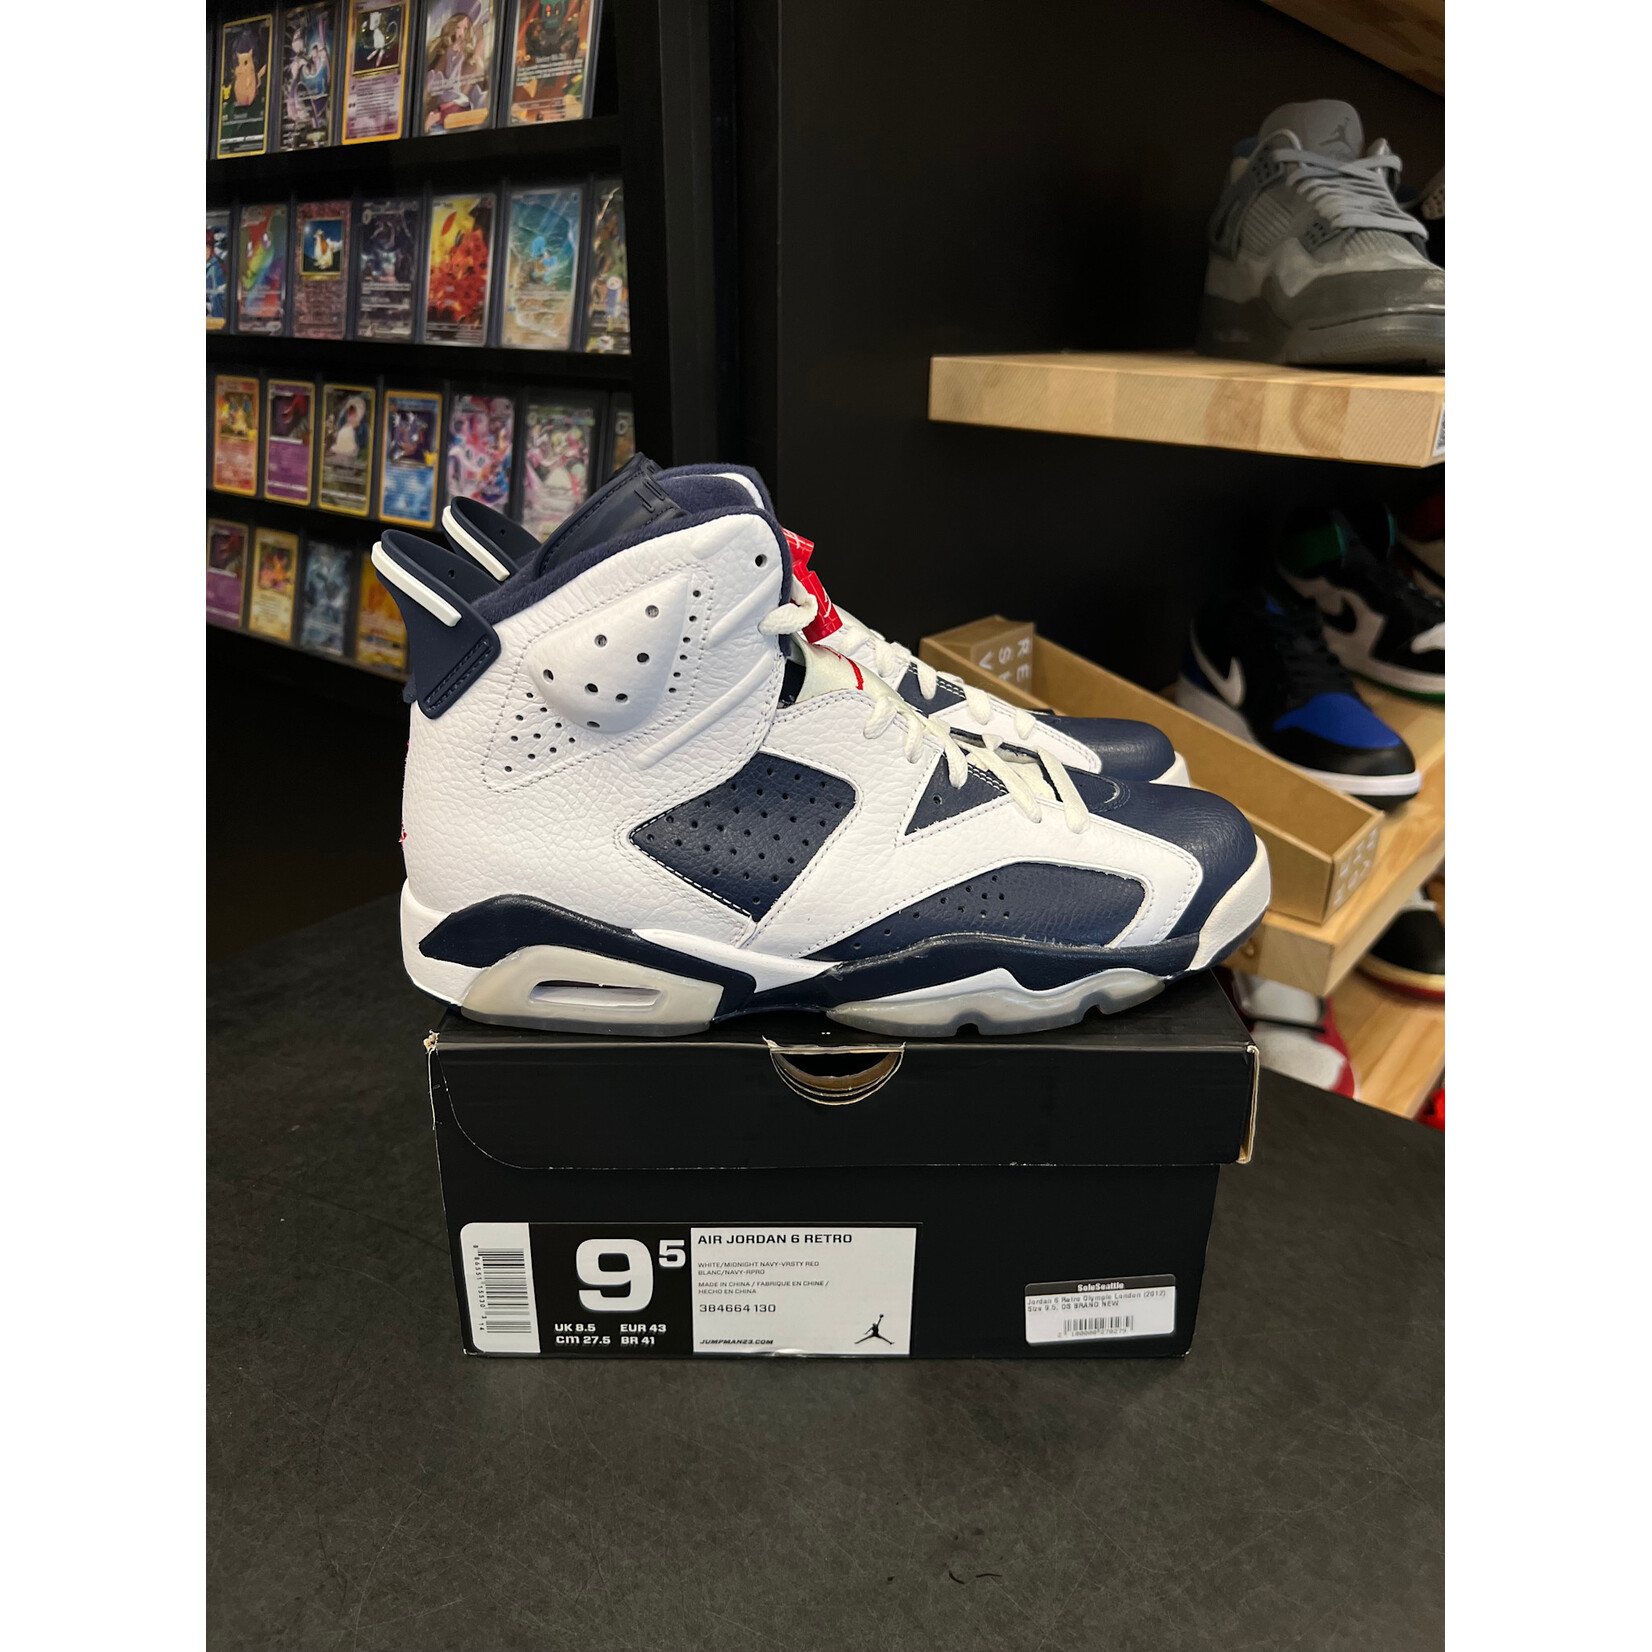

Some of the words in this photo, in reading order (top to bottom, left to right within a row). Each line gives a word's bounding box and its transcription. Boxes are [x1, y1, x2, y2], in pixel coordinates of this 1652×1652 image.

[698, 1235, 722, 1244] AIR
[726, 1234, 786, 1244] JORDAN
[791, 1234, 800, 1243] 6
[804, 1234, 852, 1243] RETRO
[576, 1239, 654, 1312] 9
[659, 1240, 686, 1268] 5
[1077, 1281, 1124, 1292] SoleSeattle
[699, 1304, 750, 1313] 384664
[754, 1304, 776, 1313] 130
[555, 1324, 572, 1332] UK
[575, 1324, 596, 1332] 8.5
[620, 1324, 646, 1332] EUR
[650, 1324, 667, 1332] 43
[583, 1336, 611, 1344] 27.5
[621, 1336, 639, 1344] BR
[641, 1336, 655, 1344] 41
